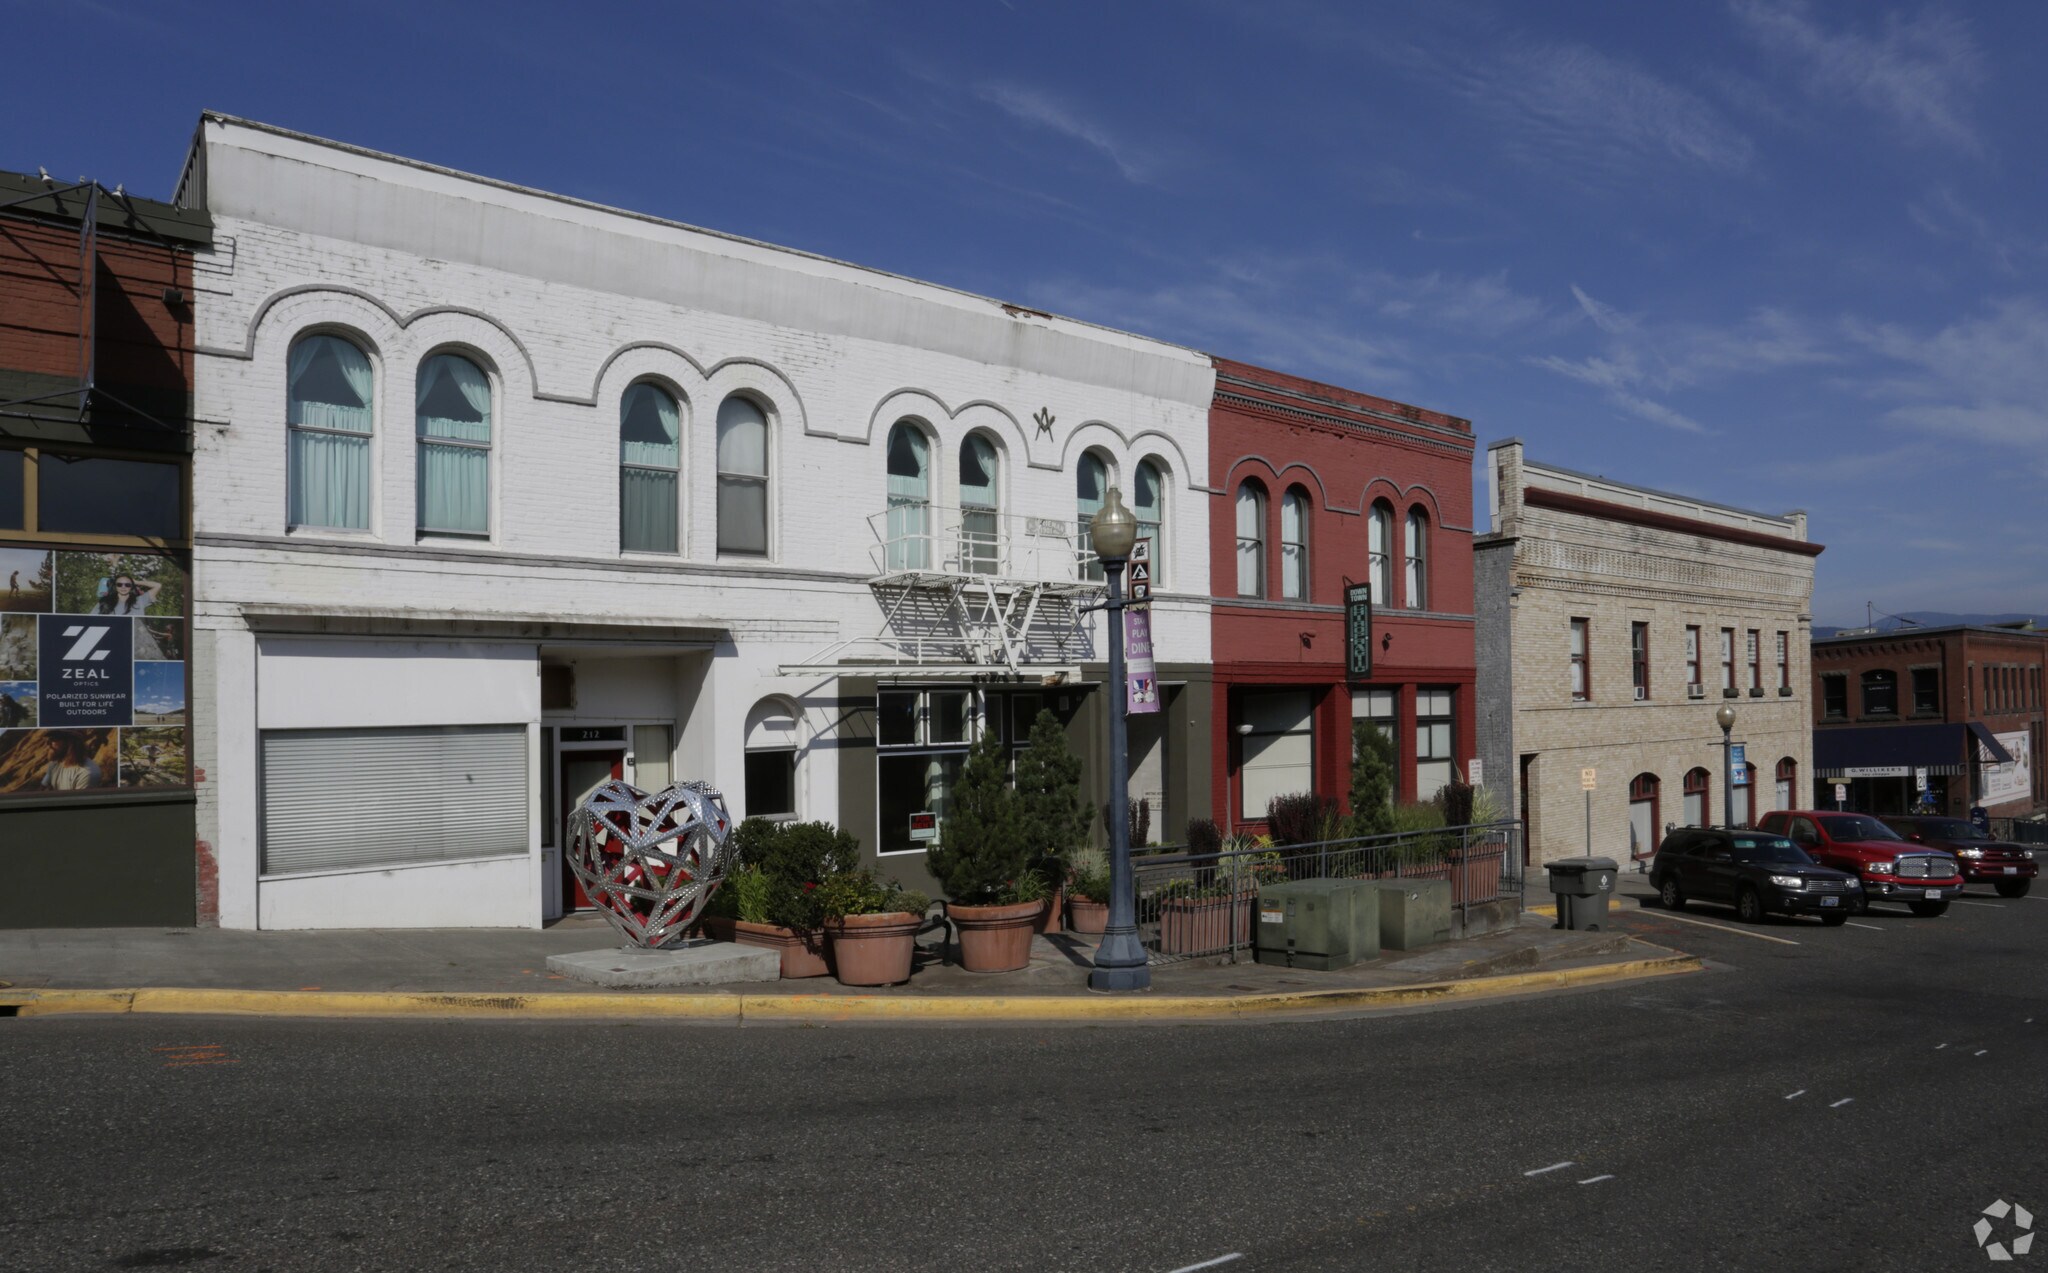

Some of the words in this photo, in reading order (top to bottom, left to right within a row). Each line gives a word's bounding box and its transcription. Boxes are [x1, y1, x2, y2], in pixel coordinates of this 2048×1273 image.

[1350, 587, 1368, 596] DOWN
[1350, 594, 1368, 602] TOWN
[1132, 629, 1148, 638] PLAY
[1131, 642, 1151, 654] DINE
[62, 668, 110, 679] ZEAL
[582, 730, 600, 739] 212
[912, 821, 934, 829] RENT
